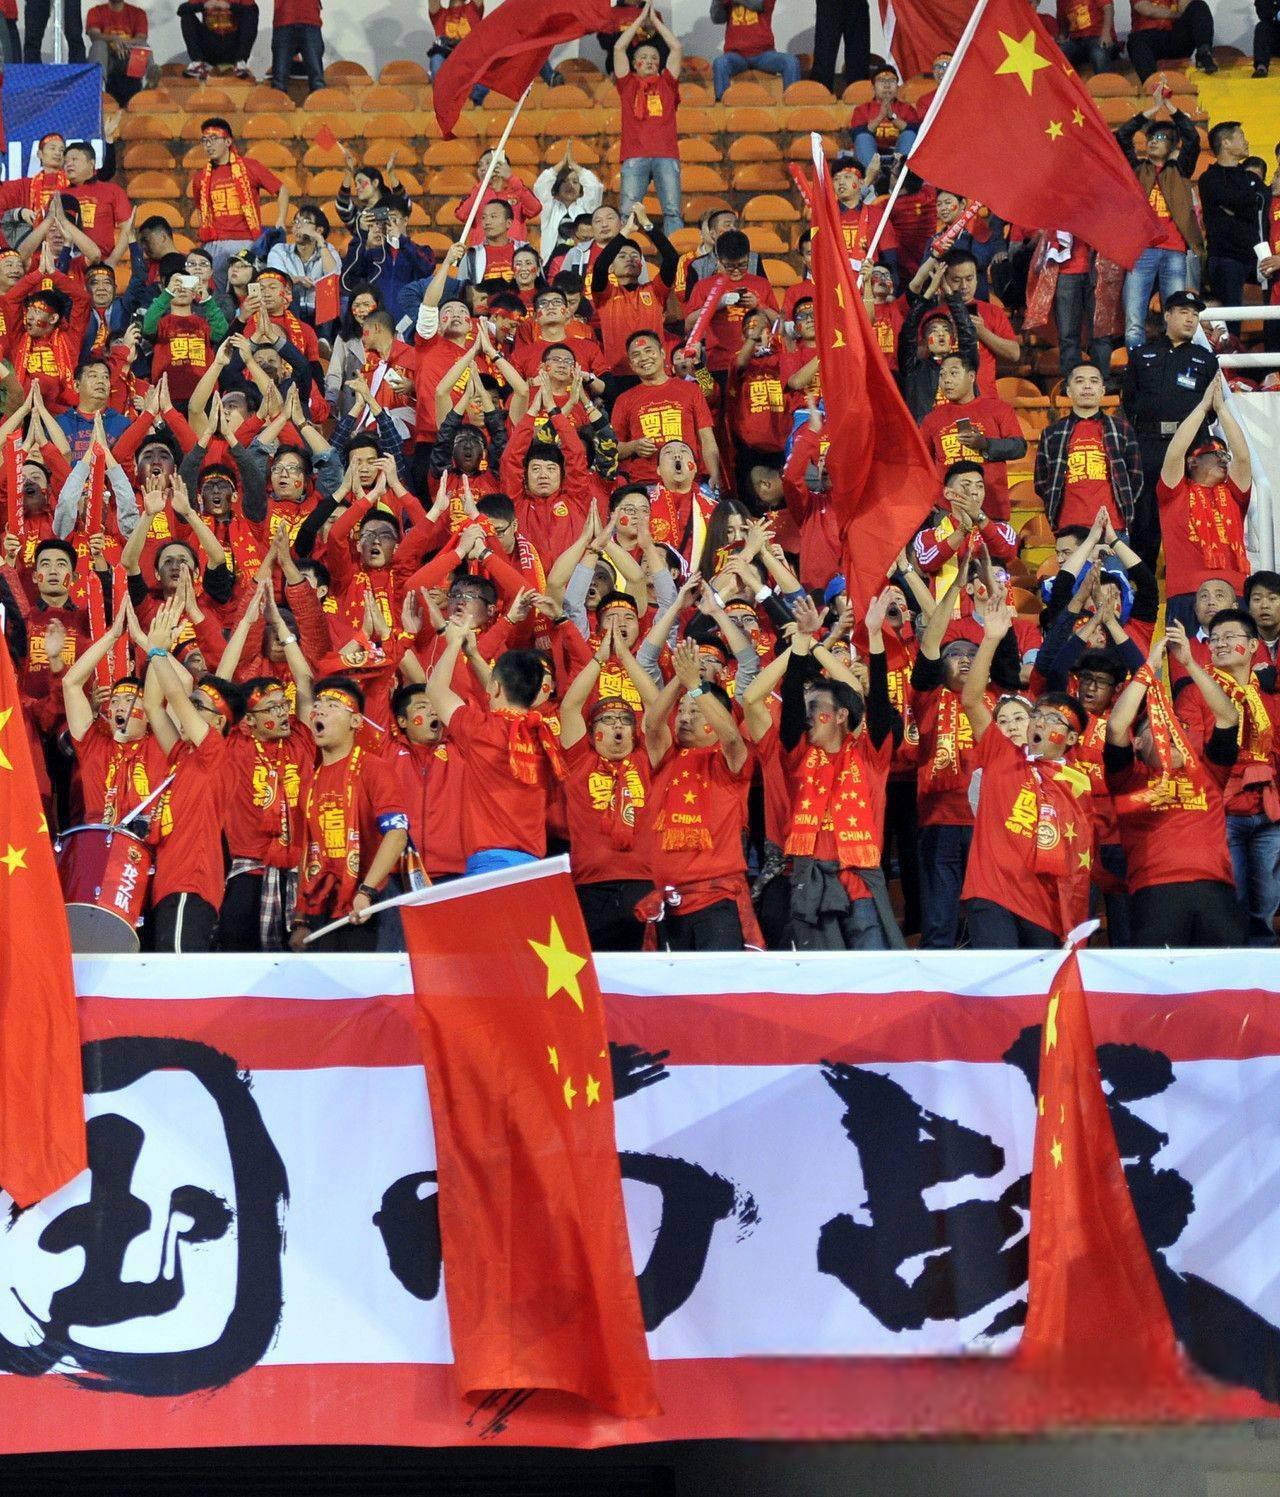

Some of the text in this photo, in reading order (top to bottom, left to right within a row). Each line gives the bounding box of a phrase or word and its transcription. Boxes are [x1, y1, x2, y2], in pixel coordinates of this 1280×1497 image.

[170, 337, 207, 360] 要赢
[749, 379, 784, 406] 要赢
[639, 409, 682, 438] 要赢
[1066, 450, 1108, 479] 要赢
[671, 813, 702, 825] CHINA
[839, 830, 872, 842] CHINA
